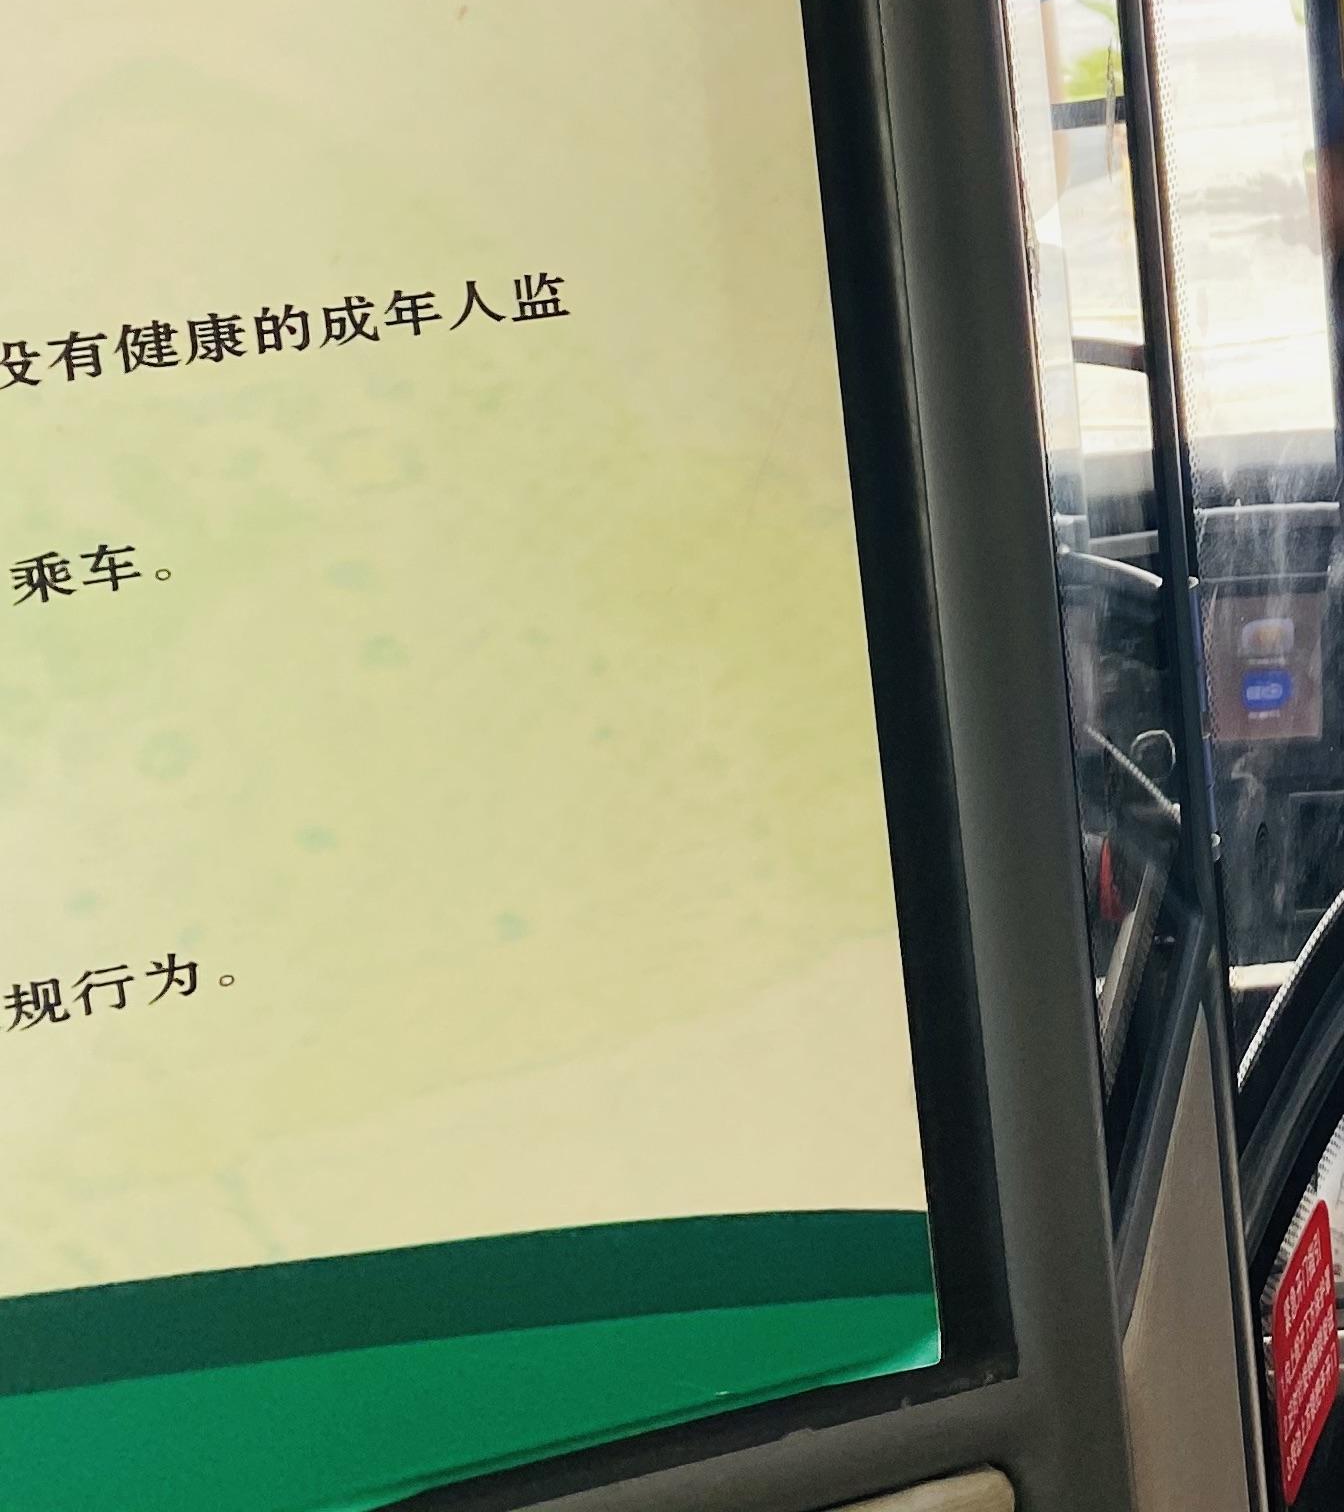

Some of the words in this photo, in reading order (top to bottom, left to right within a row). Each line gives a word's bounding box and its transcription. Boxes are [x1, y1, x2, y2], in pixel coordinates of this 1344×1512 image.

[10, 545, 172, 605] 乘车。
[0, 953, 236, 1032] 规行为。
